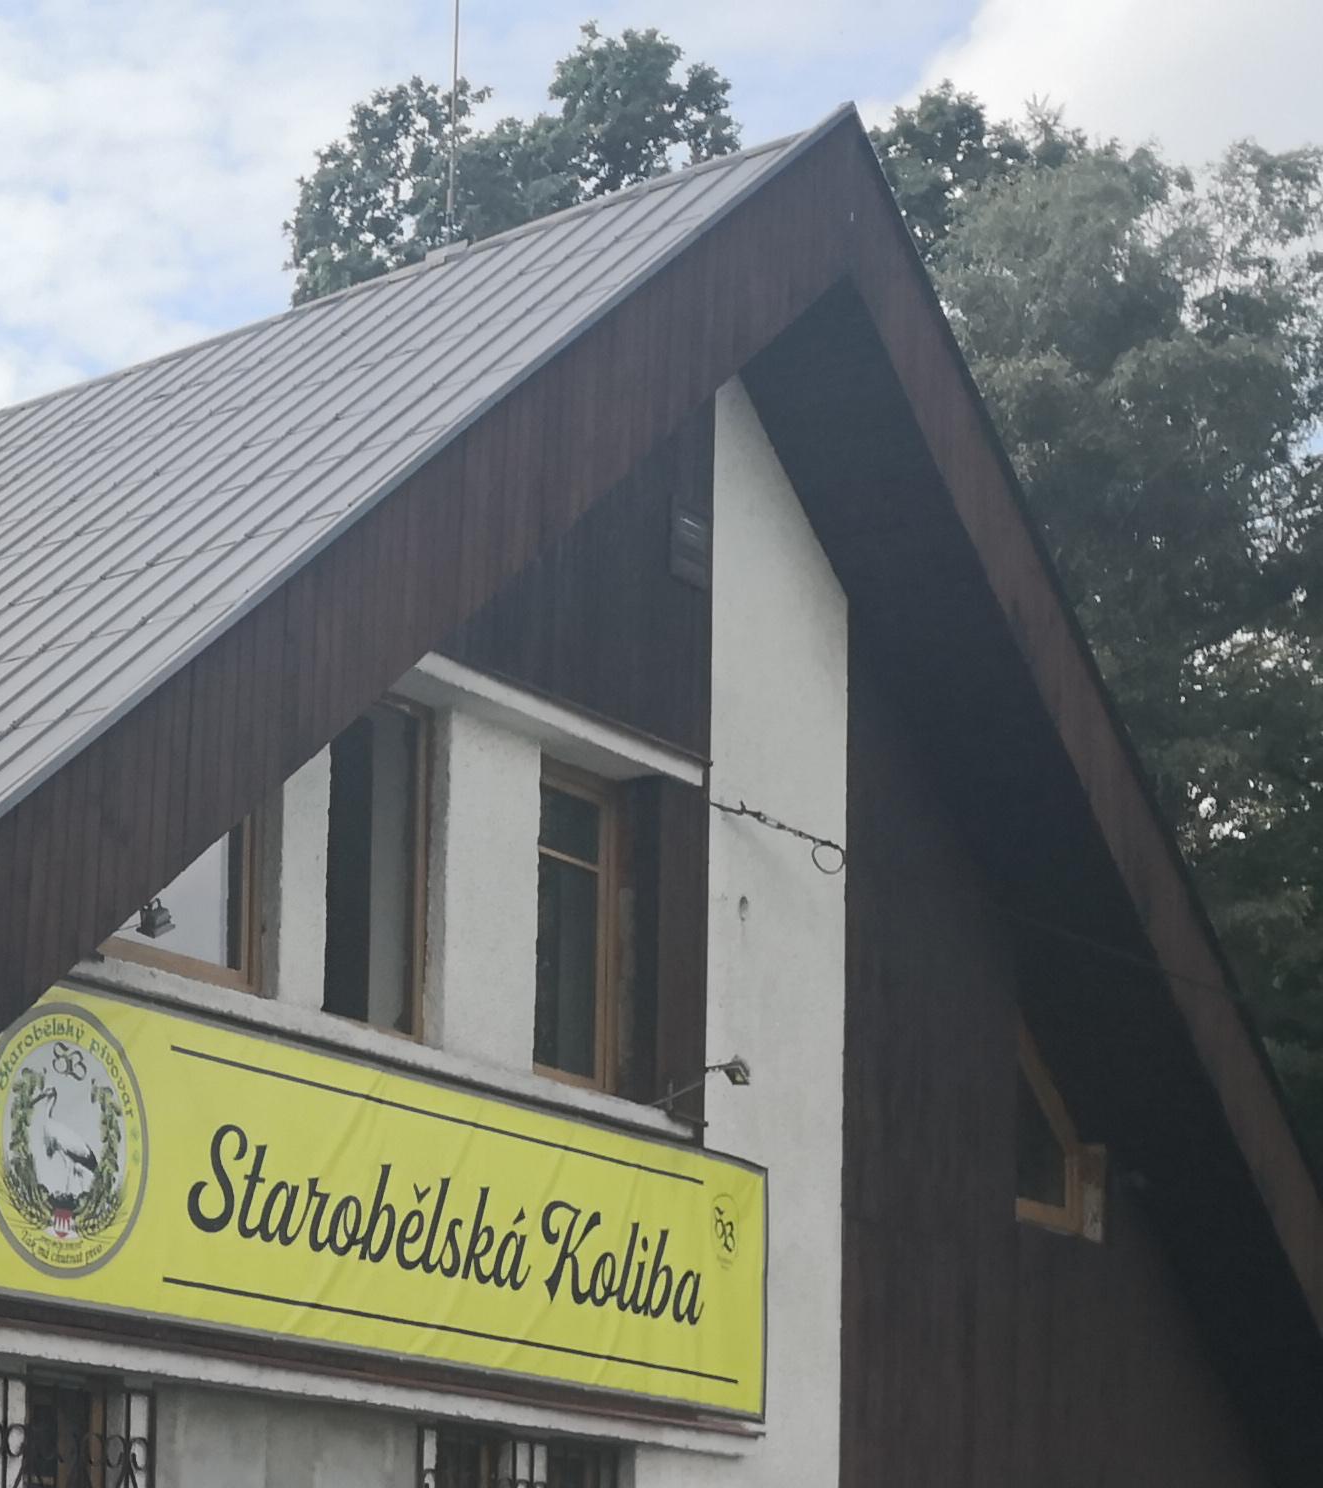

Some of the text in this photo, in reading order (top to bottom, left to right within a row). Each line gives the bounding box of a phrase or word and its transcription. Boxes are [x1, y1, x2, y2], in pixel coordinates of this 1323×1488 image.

[89, 1038, 135, 1118] pivovar
[187, 1124, 705, 1325] Starobělská Koliba
